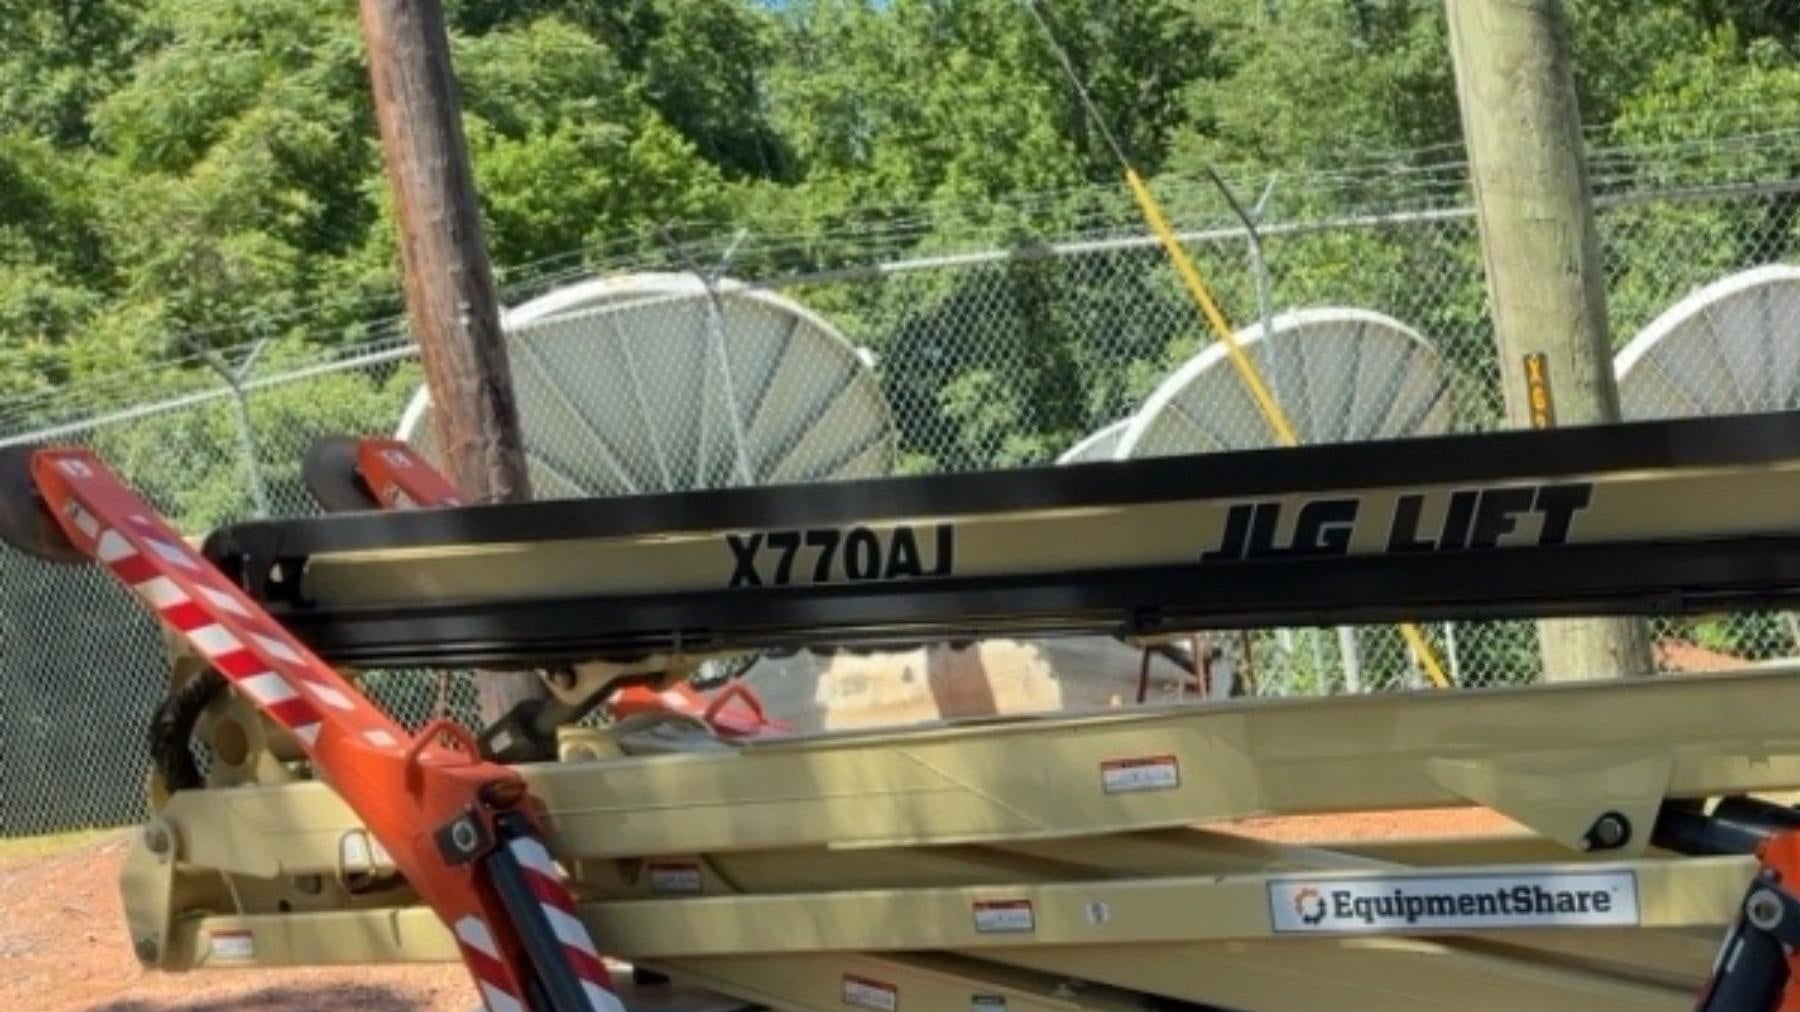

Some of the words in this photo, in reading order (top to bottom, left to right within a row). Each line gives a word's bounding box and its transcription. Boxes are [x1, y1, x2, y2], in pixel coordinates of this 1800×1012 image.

[1201, 498, 1361, 560] JLG
[1388, 482, 1594, 553] LIFT
[725, 523, 955, 589] X770AJ
[1331, 884, 1613, 925] EquipmentShare
